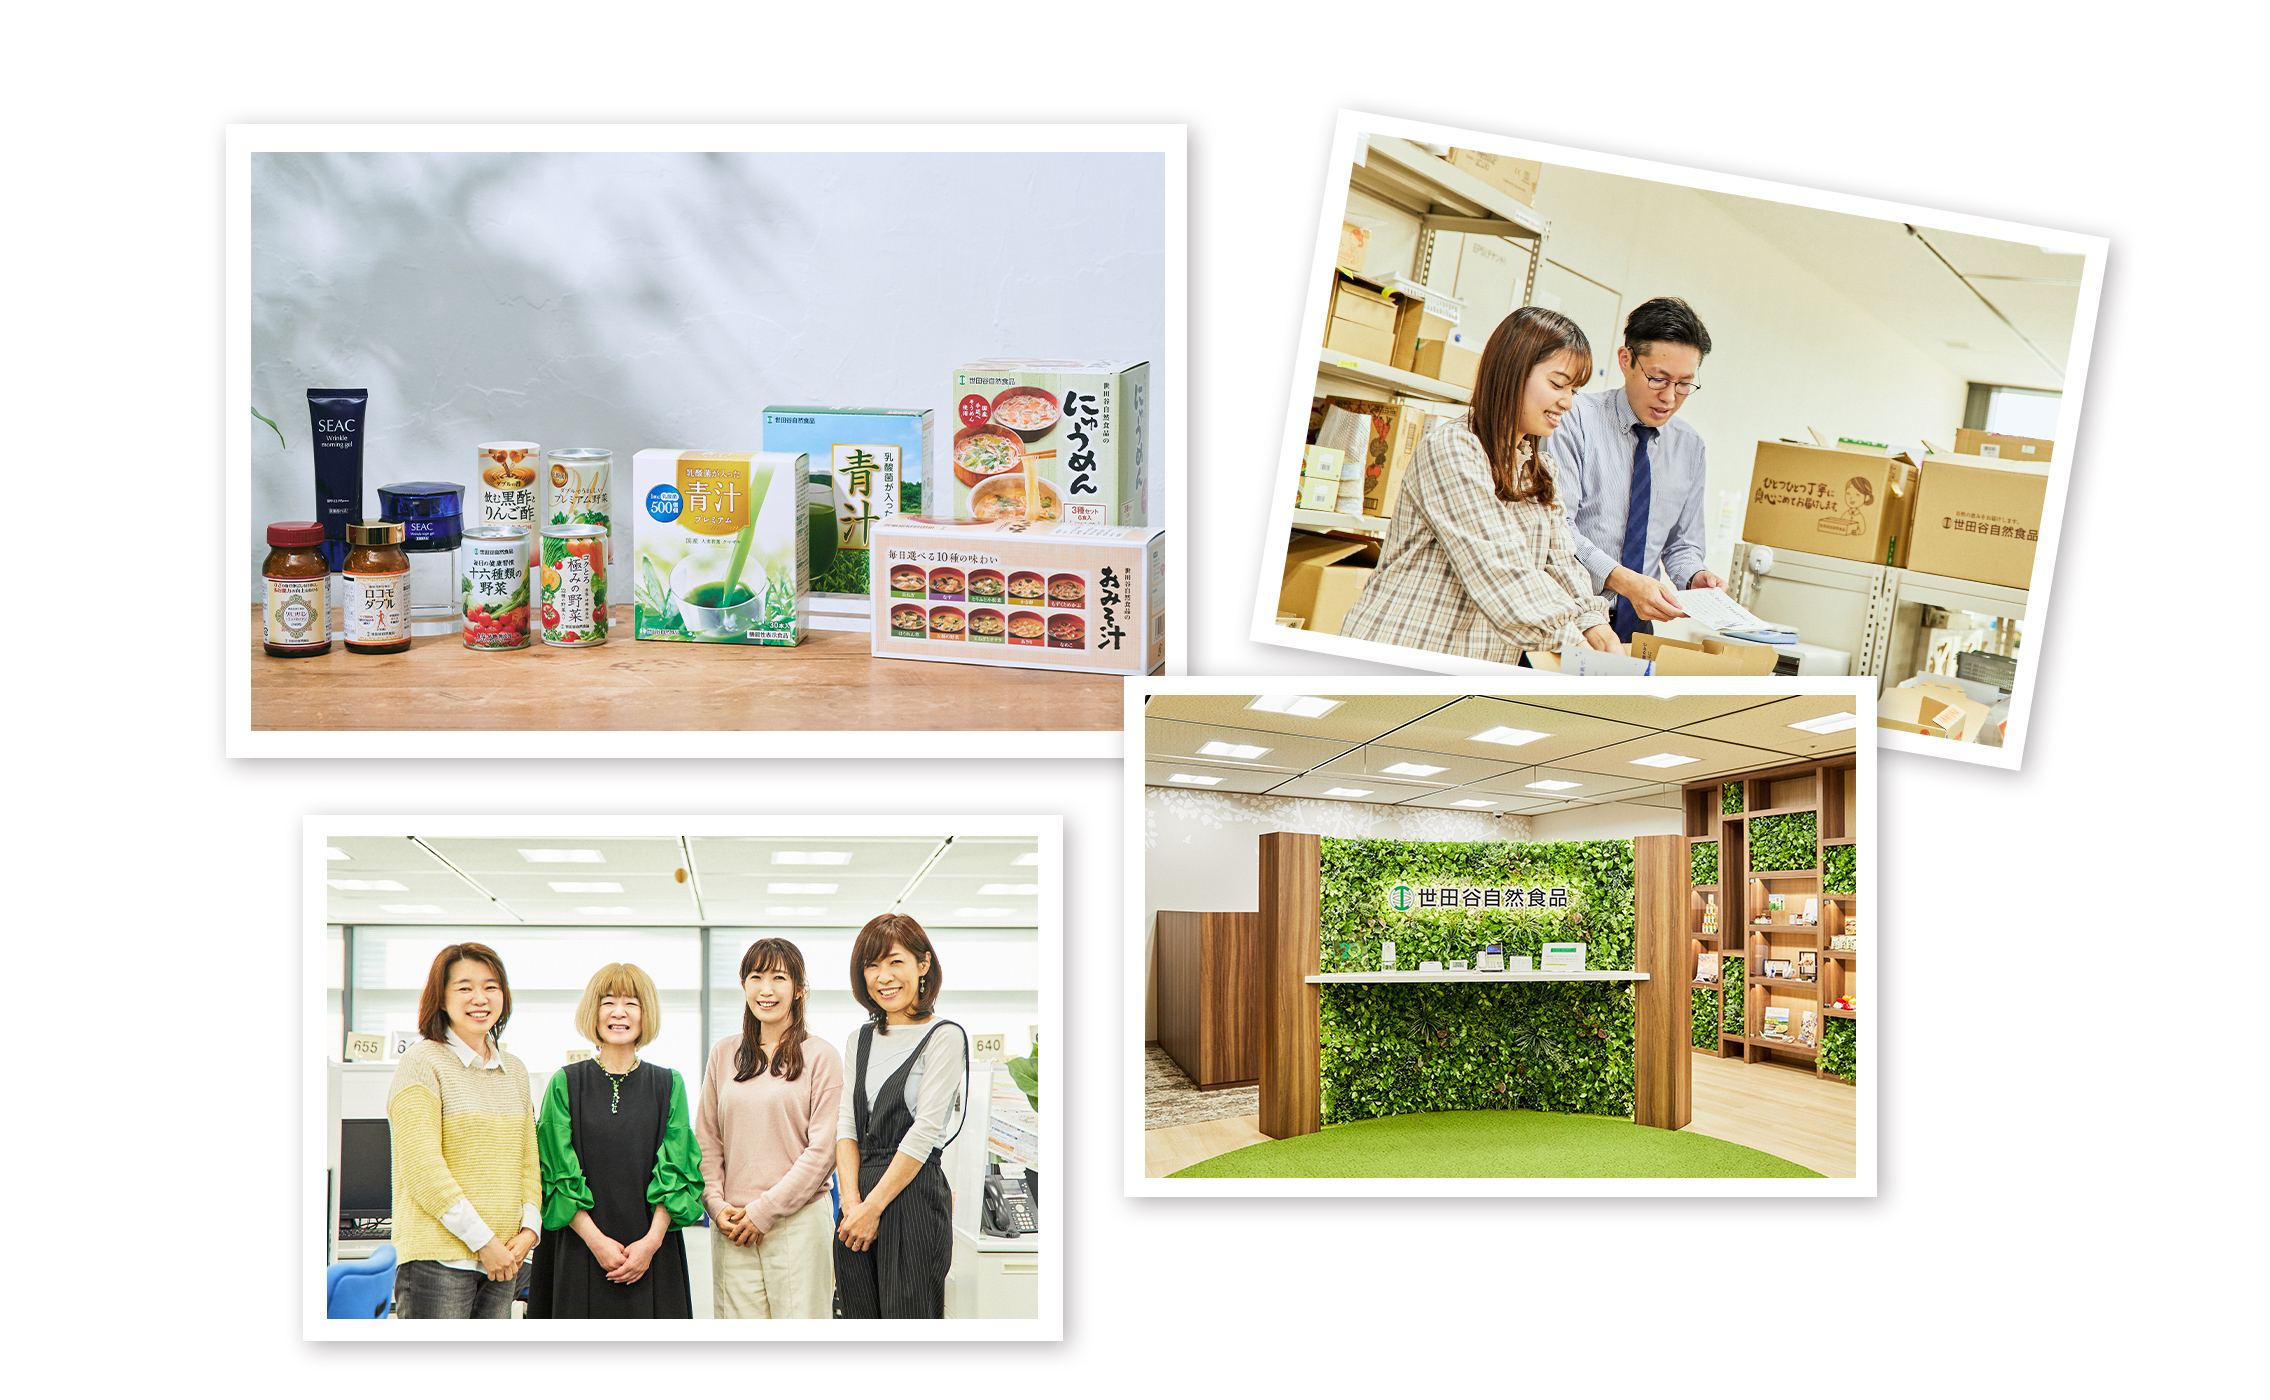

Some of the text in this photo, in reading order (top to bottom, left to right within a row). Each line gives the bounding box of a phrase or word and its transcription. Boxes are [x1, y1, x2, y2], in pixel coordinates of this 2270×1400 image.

[969, 377, 1016, 386] 世田谷自然食品
[1102, 382, 1110, 444] 世田谷自然食品の
[318, 418, 356, 432] SEAC
[775, 417, 816, 425] 世田谷自然食品
[345, 441, 353, 449] gel
[1063, 390, 1100, 495] にゅうめん
[686, 468, 741, 479] 乳酸菌が入った
[884, 452, 894, 517] 乳酸菌が入った
[1763, 477, 1835, 498] ひとつひとつ丁寧に
[484, 489, 536, 506] 飲む黒酢と
[554, 493, 609, 504] プレミアム野菜
[685, 481, 742, 513] 青汁
[838, 448, 882, 547] 青汁
[1754, 487, 1838, 512] 真心こめてお届けします。
[485, 505, 535, 521] りんご酢
[1071, 506, 1099, 515] 3種セット
[694, 515, 733, 524] プレミアム
[411, 523, 434, 531] SEAC
[1954, 518, 2039, 542] 世田谷自然食品
[888, 550, 998, 564] 毎日選べる10種の味わい
[469, 567, 522, 580] 十六種類の
[583, 554, 591, 584] コクとろ
[365, 588, 395, 598] ロコモ
[479, 581, 508, 596] 野菜
[567, 558, 583, 623] 極みの野菜
[1123, 567, 1131, 621] 世田谷自然食品の
[364, 599, 396, 610] ダブル
[1097, 565, 1126, 650] おみそ汁
[769, 621, 791, 630] 30本入
[1417, 887, 1568, 908] 世田谷自然食品
[353, 1040, 378, 1054] 655
[976, 1039, 1001, 1052] 640
